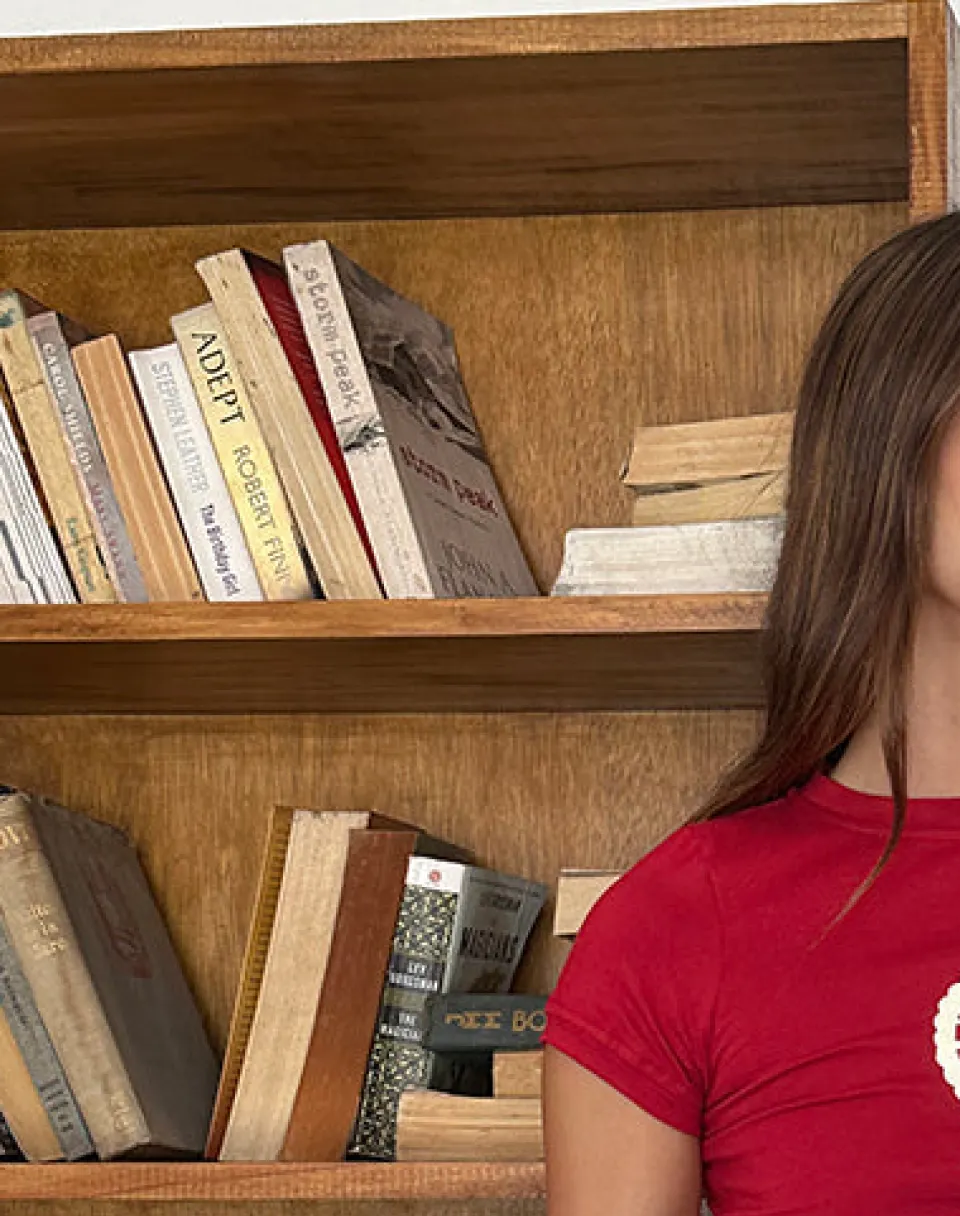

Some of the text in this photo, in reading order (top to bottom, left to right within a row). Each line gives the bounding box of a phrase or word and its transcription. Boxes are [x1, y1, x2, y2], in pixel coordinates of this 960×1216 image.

[191, 333, 246, 424] ADEPT
[303, 267, 361, 408] storm peak
[151, 361, 210, 493] STEPHEN LEATHER
[233, 444, 276, 529] ROBERT
